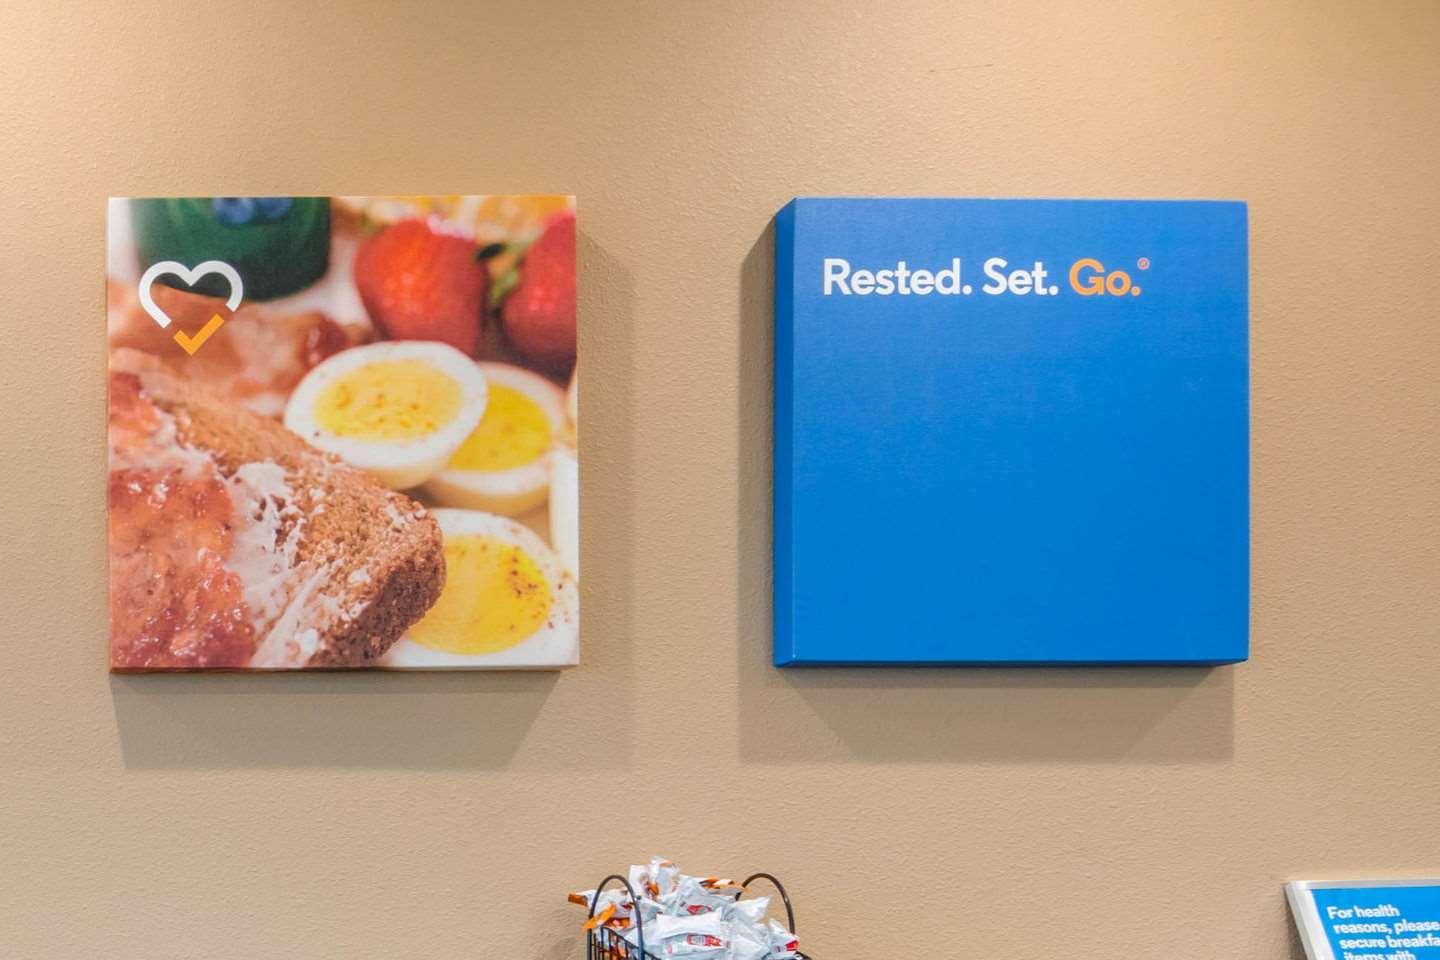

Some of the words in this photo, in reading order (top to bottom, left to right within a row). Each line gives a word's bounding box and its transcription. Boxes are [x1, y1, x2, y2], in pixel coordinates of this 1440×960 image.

[823, 258, 972, 295] Rested.
[983, 258, 1058, 295] Set.
[1327, 906, 1353, 919] For
[1354, 904, 1400, 918] health
[1333, 923, 1392, 934] reasons,
[1394, 919, 1440, 934] please
[1339, 939, 1386, 949] secure
